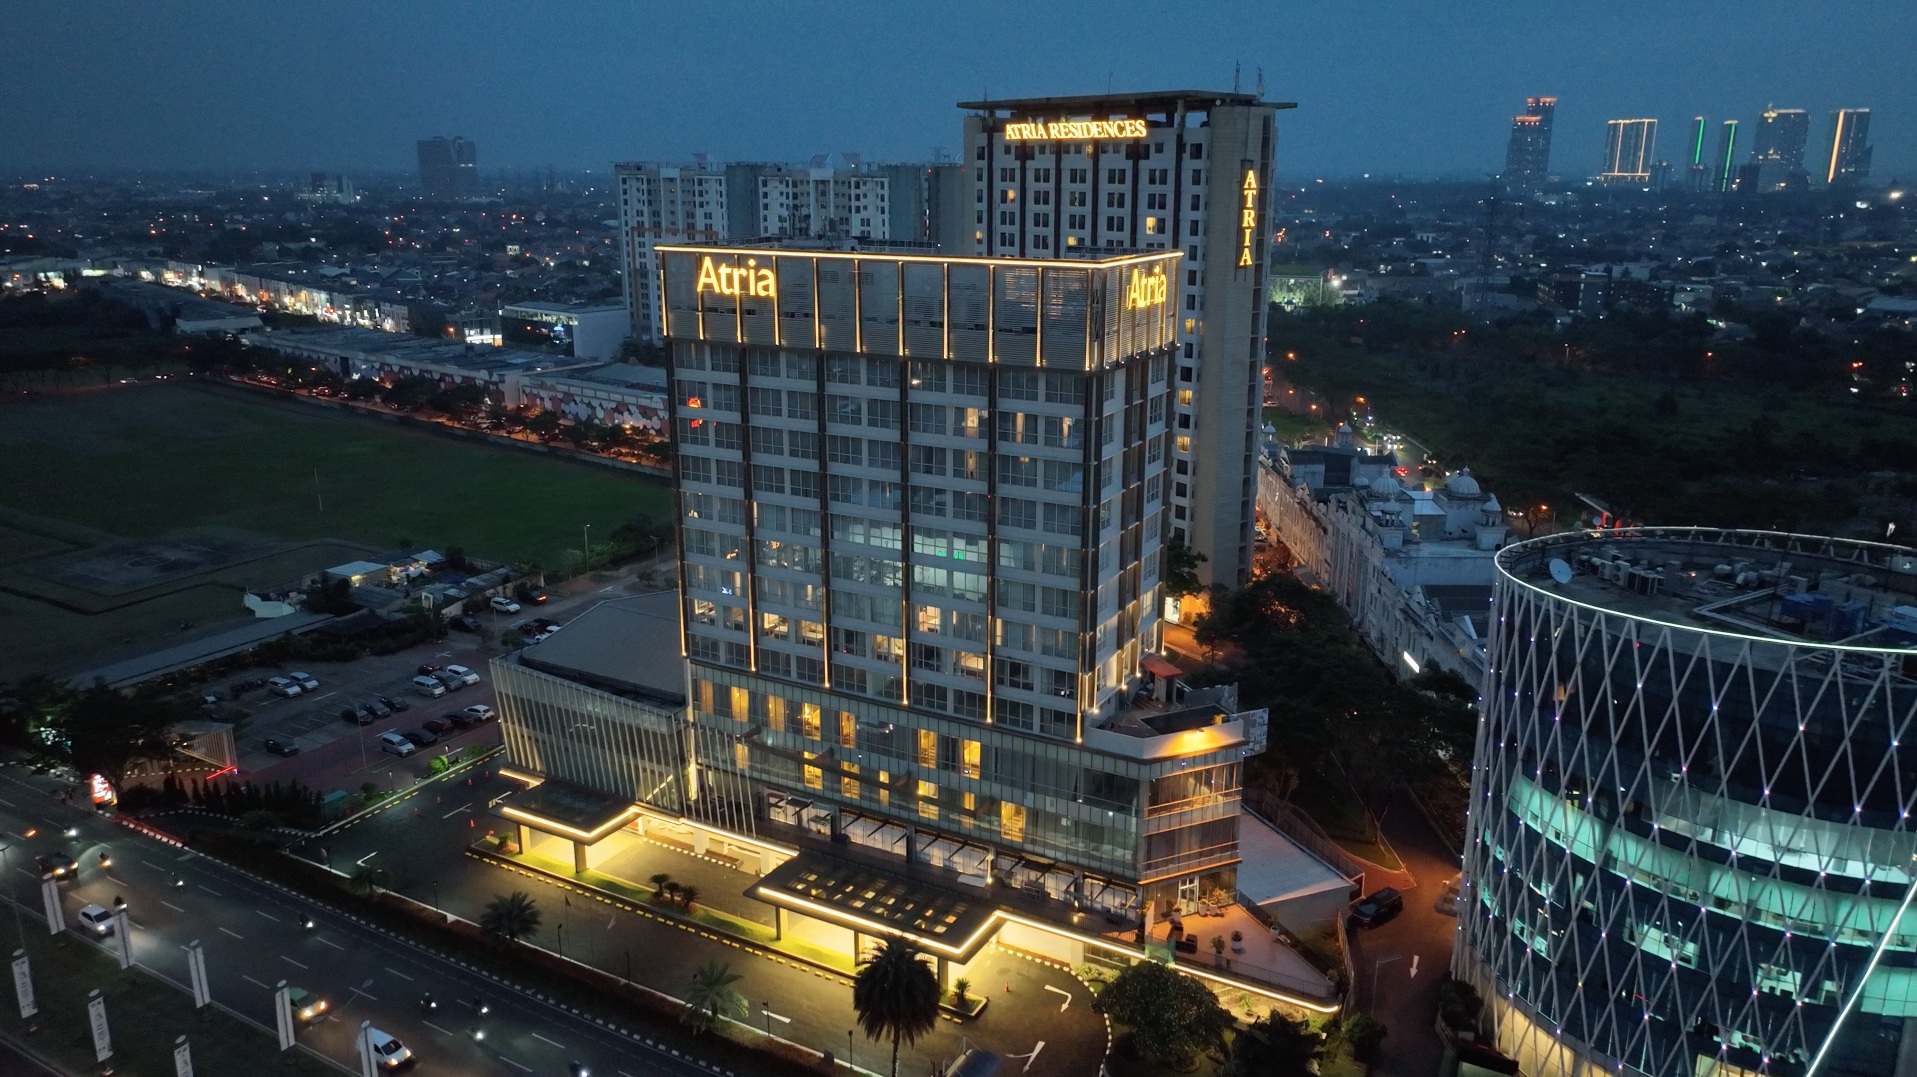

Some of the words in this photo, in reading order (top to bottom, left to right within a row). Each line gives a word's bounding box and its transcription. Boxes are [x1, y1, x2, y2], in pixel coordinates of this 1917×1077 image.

[1005, 122, 1049, 140] ATRIA
[1048, 119, 1147, 139] RESIDENCES
[1239, 169, 1258, 266] ATRIA
[696, 255, 776, 297] Atria
[1127, 264, 1168, 311] Atria
